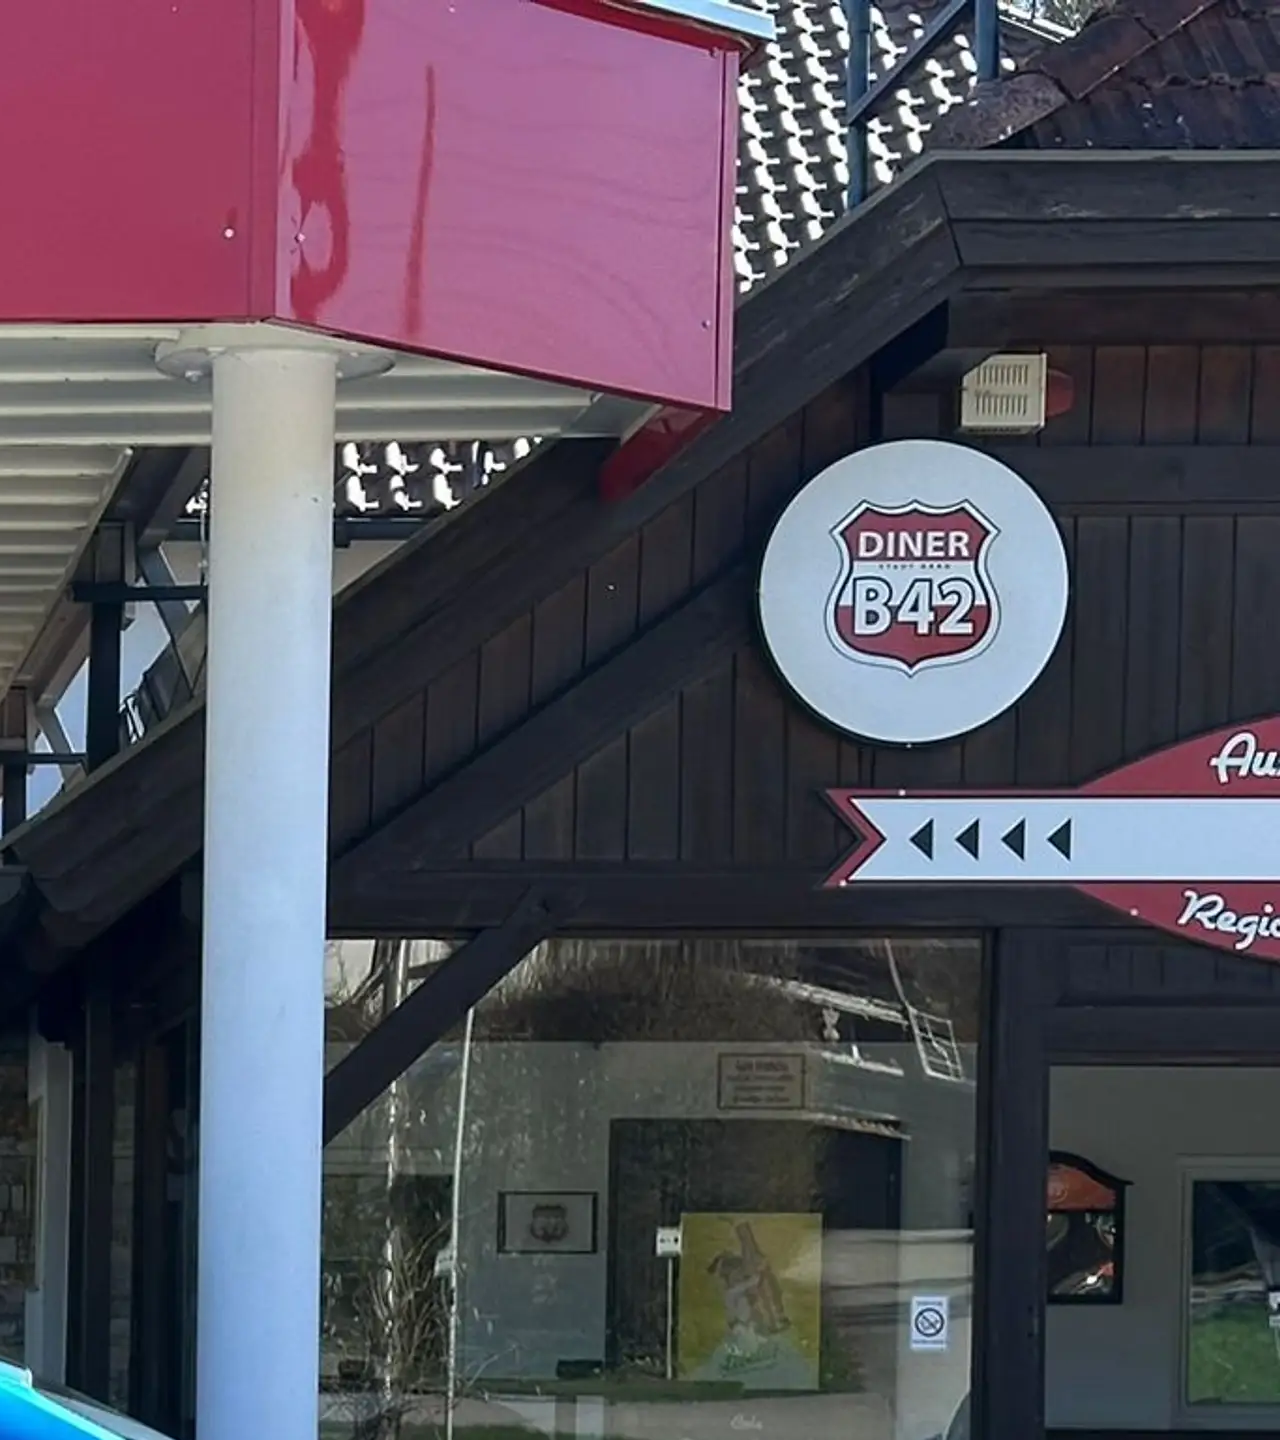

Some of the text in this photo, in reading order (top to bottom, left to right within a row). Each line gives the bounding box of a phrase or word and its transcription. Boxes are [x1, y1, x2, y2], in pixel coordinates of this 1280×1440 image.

[858, 530, 971, 558] DINER
[852, 575, 977, 637] B42
[1209, 731, 1280, 785] Au
